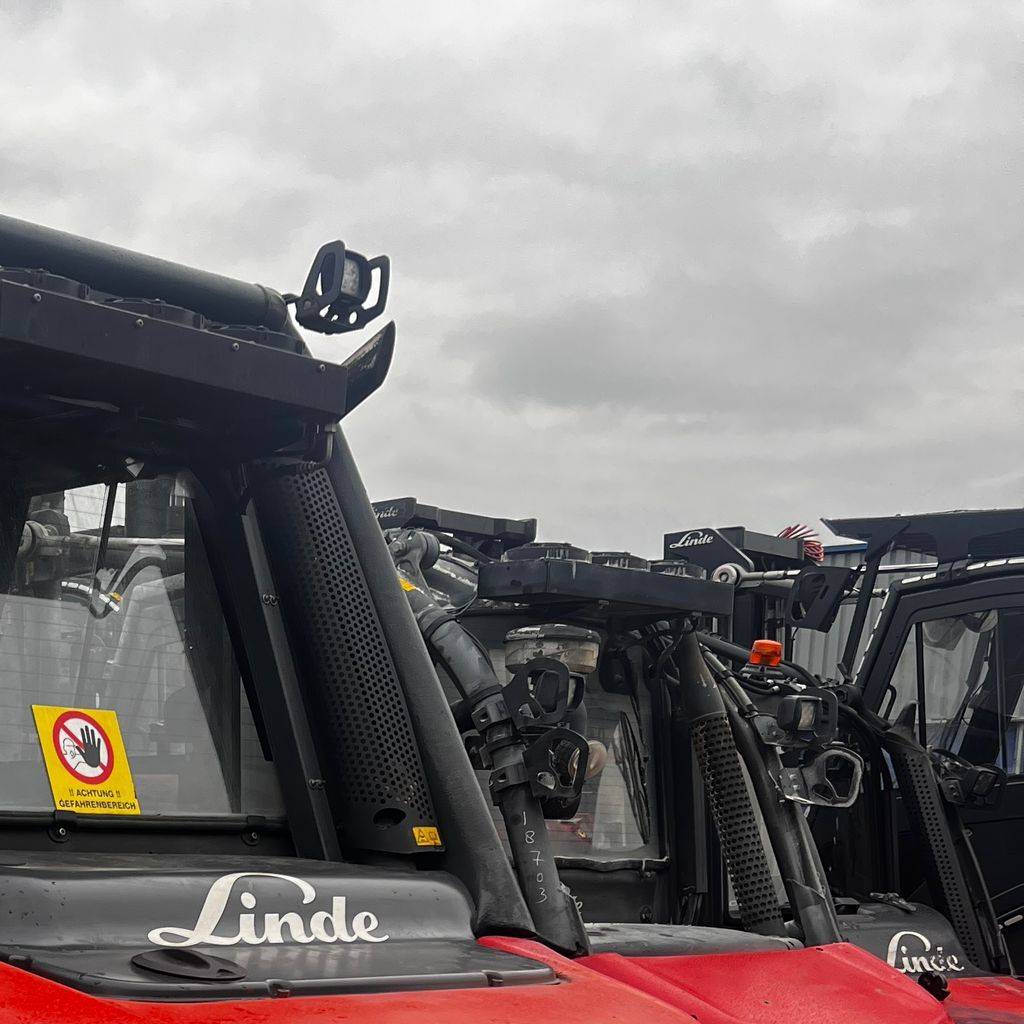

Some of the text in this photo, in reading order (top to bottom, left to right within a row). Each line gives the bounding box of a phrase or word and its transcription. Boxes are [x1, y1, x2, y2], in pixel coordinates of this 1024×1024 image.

[669, 530, 714, 549] Linde
[76, 789, 114, 798] ACHTUNG
[59, 800, 136, 810] GEFAHRENBEREICH
[147, 872, 389, 947] Linde
